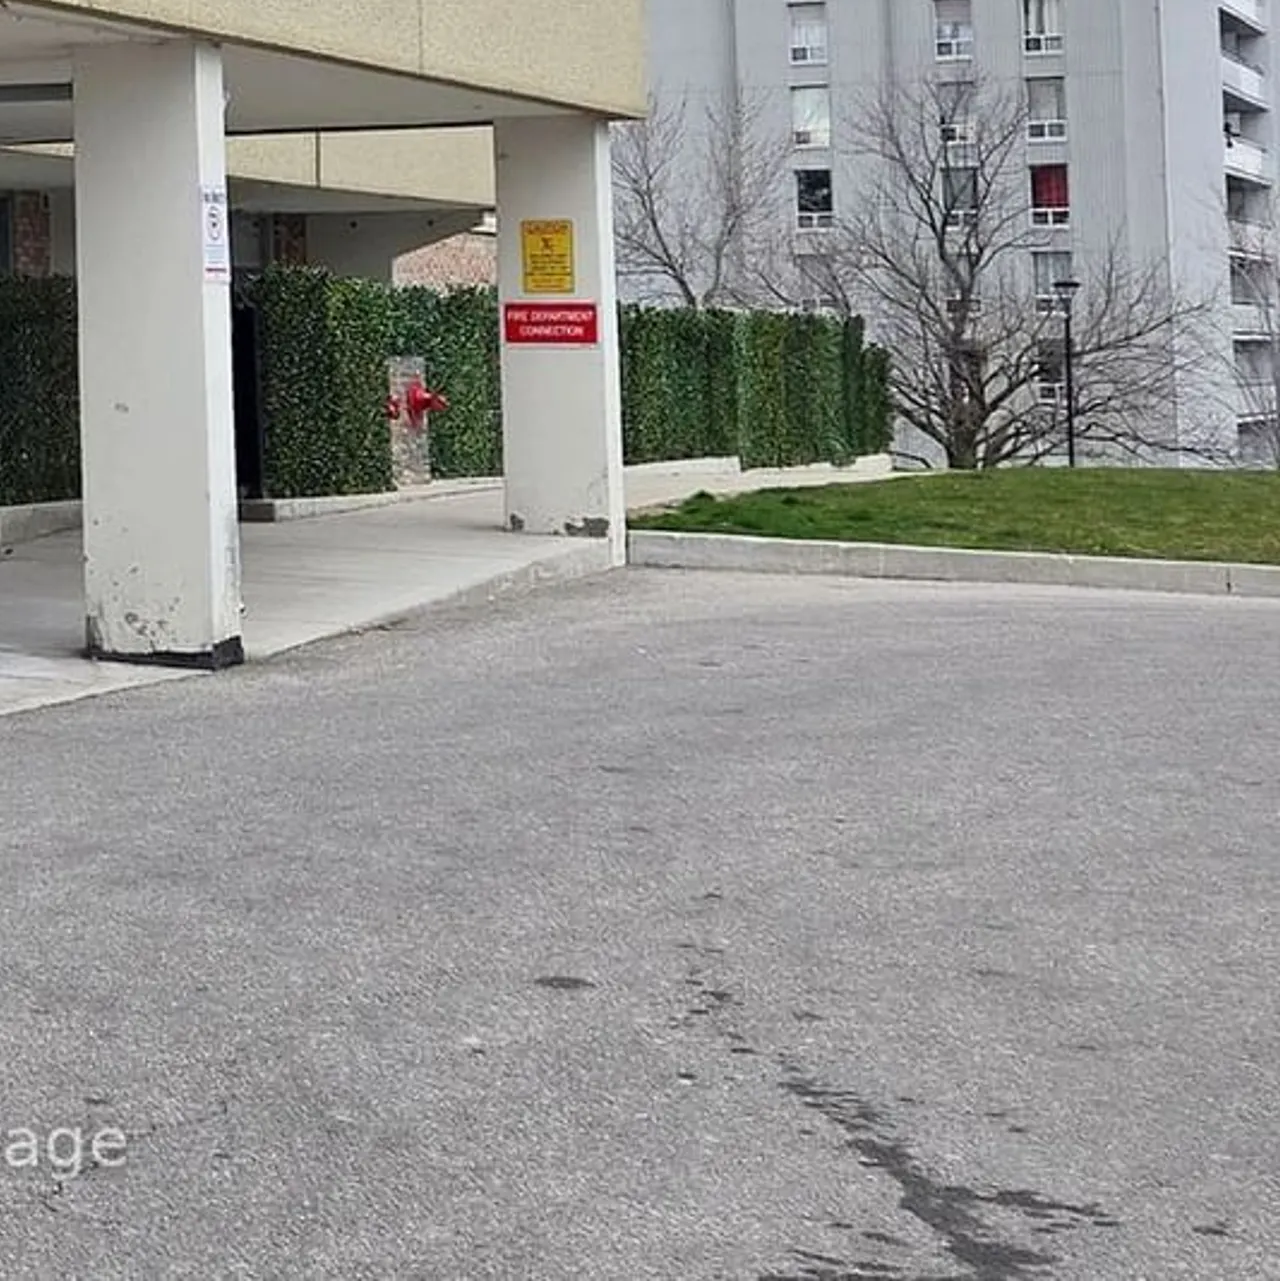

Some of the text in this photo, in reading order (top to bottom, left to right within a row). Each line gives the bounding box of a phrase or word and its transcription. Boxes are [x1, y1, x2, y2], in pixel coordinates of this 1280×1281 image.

[507, 310, 594, 322] FIRE DEPARTMENT
[519, 325, 585, 337] CONNECTION
